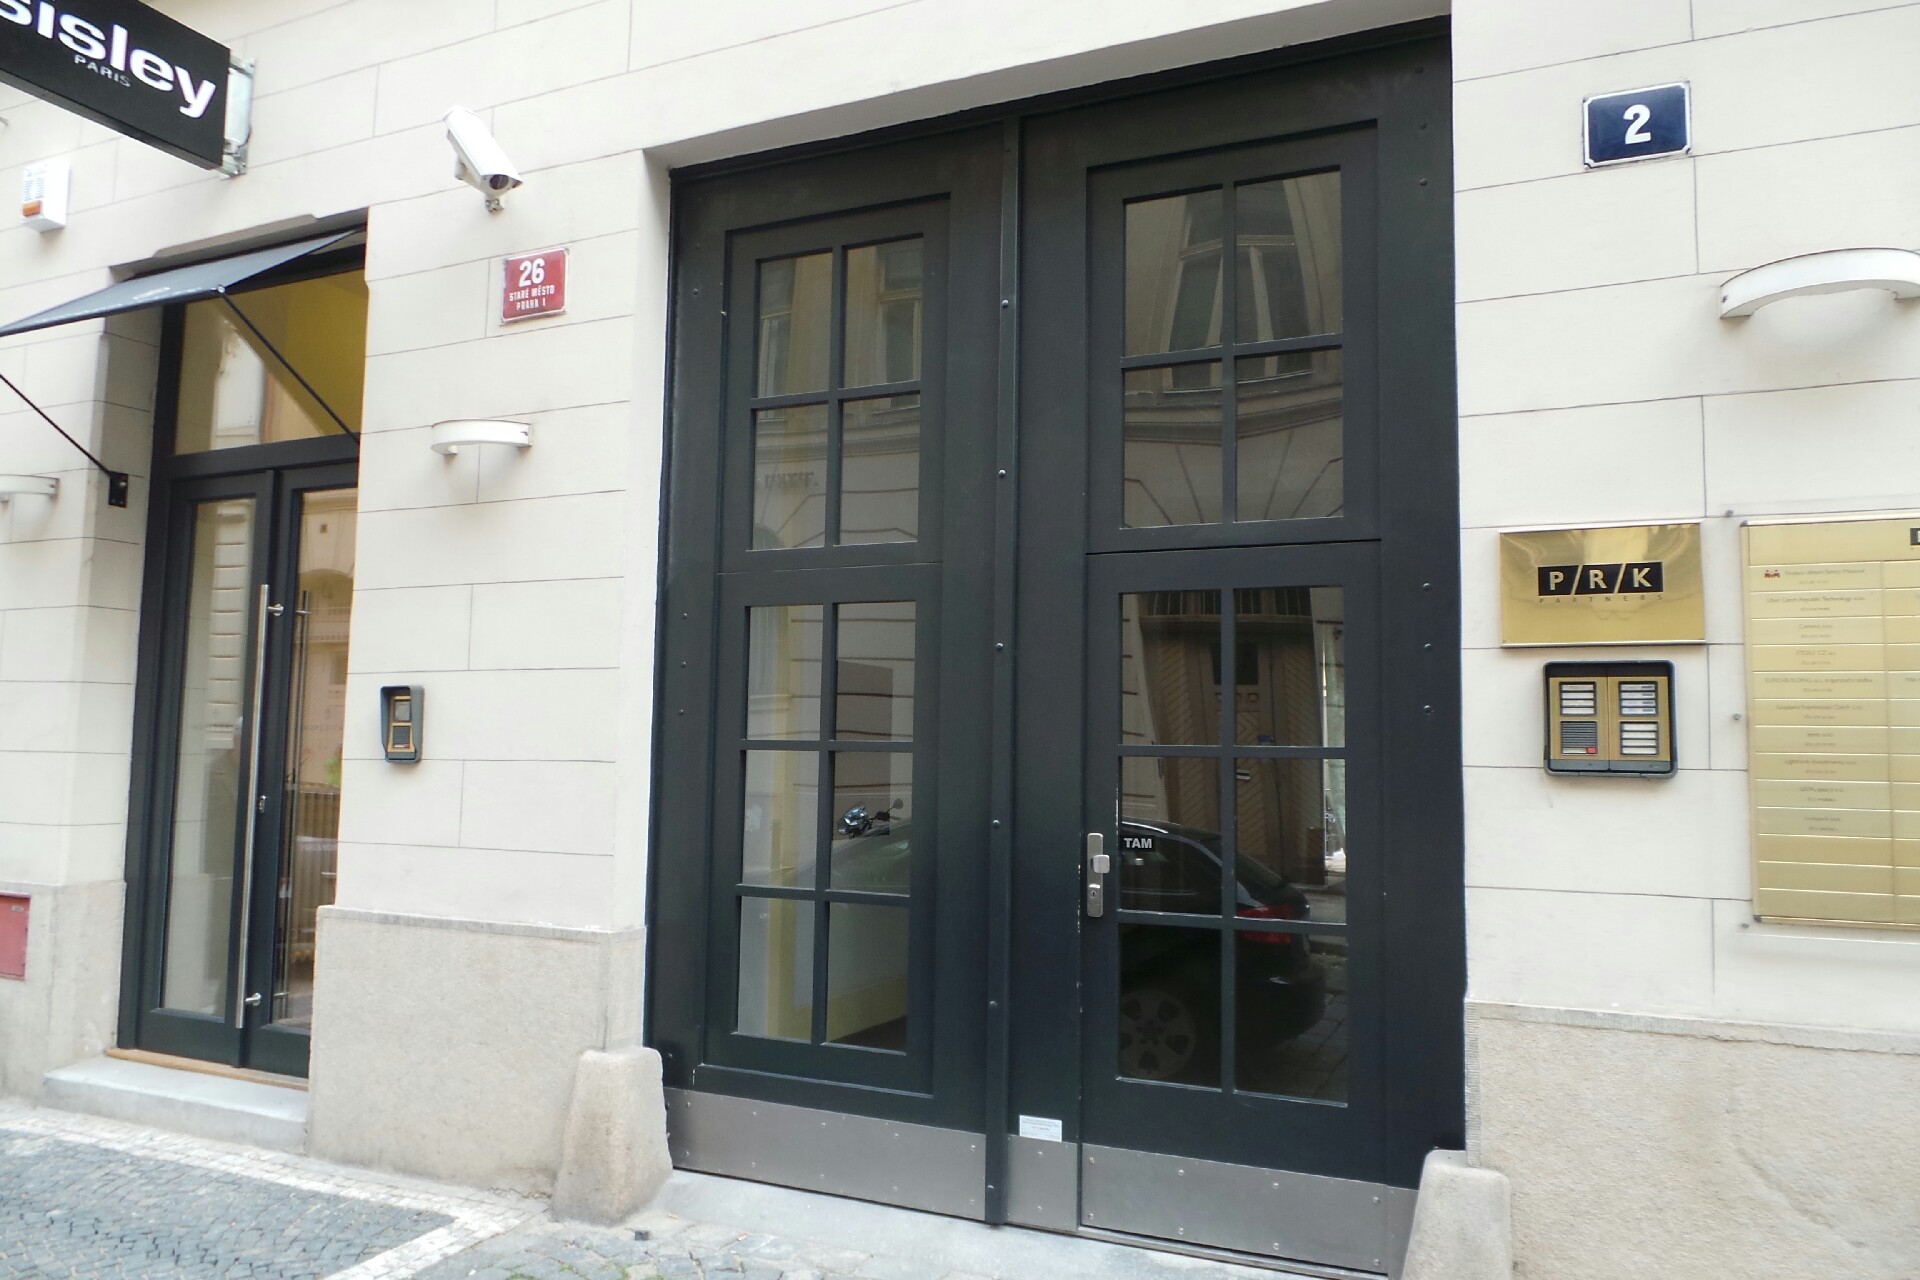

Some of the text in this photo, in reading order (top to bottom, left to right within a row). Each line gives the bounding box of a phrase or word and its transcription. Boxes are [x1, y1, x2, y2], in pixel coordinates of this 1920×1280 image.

[74, 54, 131, 87] PARIS
[1623, 104, 1652, 145] 2
[518, 258, 545, 288] 26
[509, 285, 555, 302] STARÉ MĚSTO
[516, 298, 539, 311] PRAHA
[1539, 594, 1663, 604] PARTNERS
[1123, 837, 1153, 849] TAM
